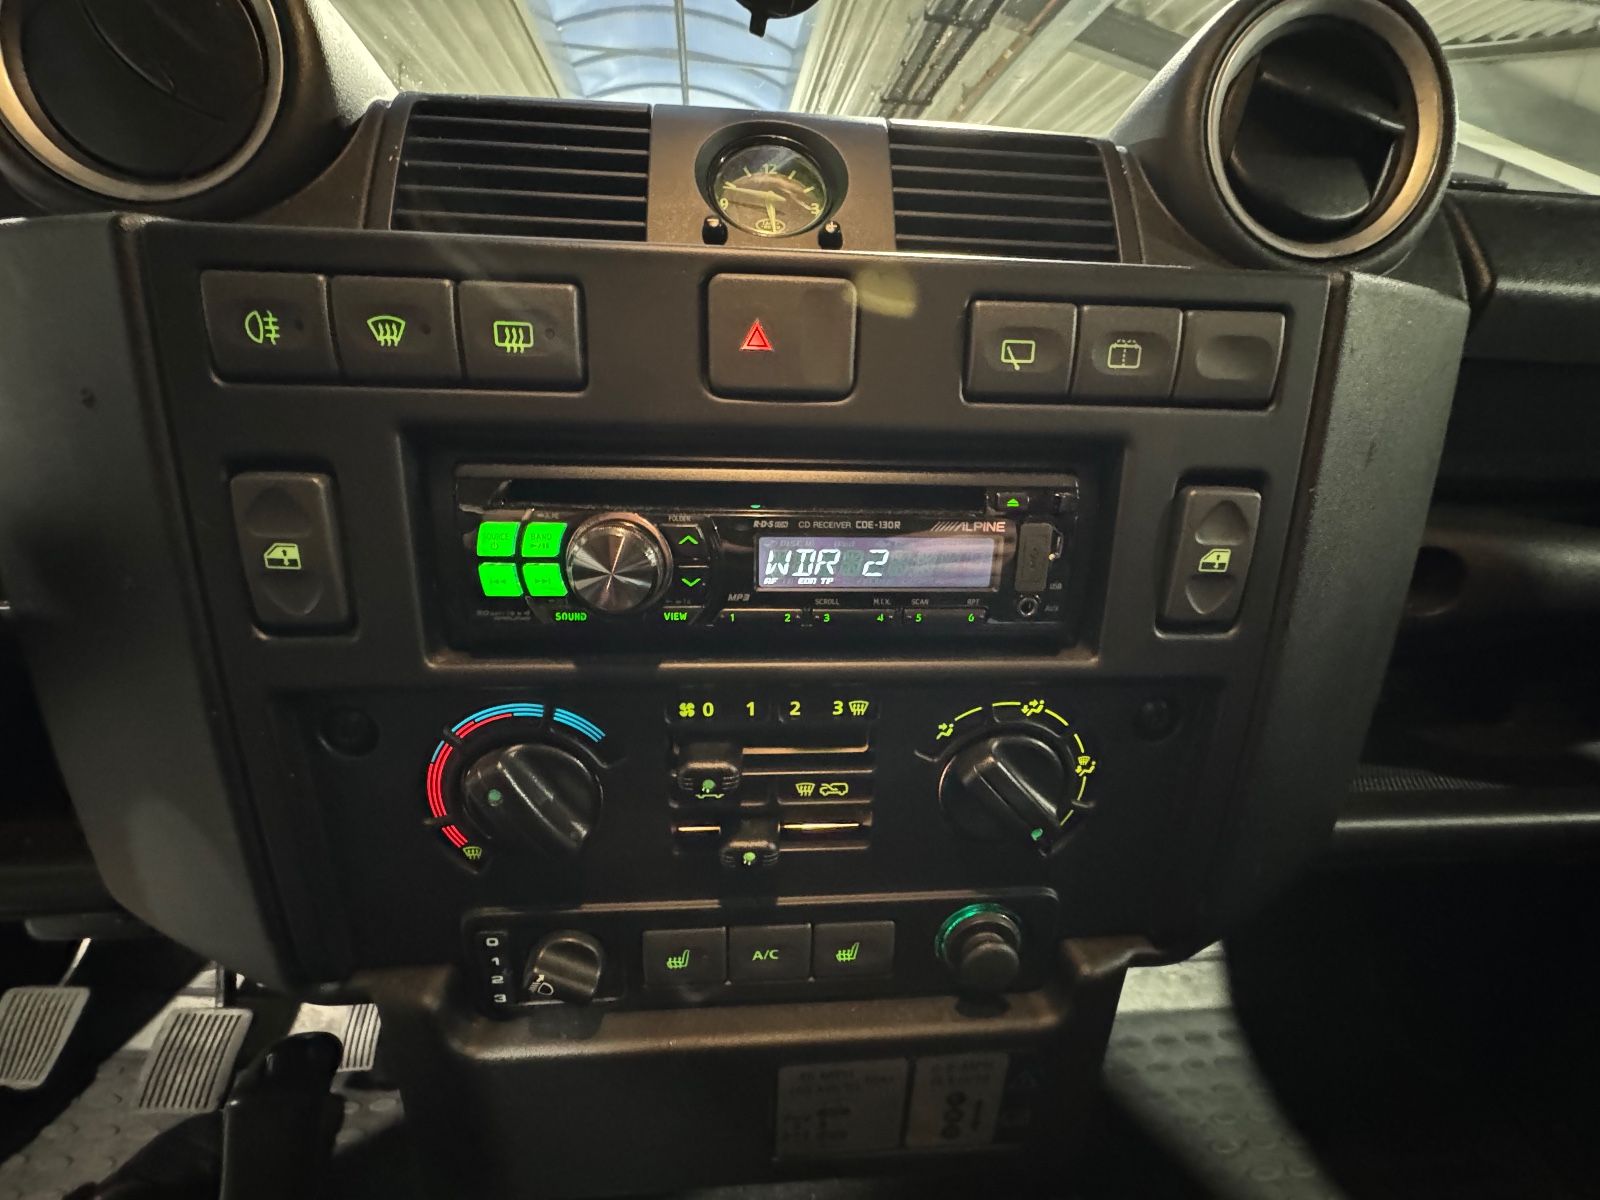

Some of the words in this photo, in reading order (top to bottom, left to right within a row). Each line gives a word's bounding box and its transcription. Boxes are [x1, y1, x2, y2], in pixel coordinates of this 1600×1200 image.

[762, 164, 777, 174] 12
[719, 198, 729, 210] 9
[810, 203, 820, 215] 3
[798, 520, 812, 529] CD
[813, 520, 852, 529] RECEIVER
[855, 520, 901, 530] CDE-130R
[953, 521, 1006, 532] ALPINE
[530, 533, 552, 541] BAND
[764, 548, 841, 577] WDR
[861, 548, 890, 577] 2
[728, 593, 750, 602] MP3
[815, 598, 840, 606] SCROLL
[911, 598, 929, 606] SCAN
[554, 611, 588, 622] SOUND
[663, 611, 688, 621] VIEW
[729, 613, 736, 623] 1
[784, 613, 791, 623] 2
[823, 613, 830, 623] 3
[877, 613, 884, 623] 4
[915, 613, 922, 623] 5
[968, 613, 975, 623] 6
[702, 701, 715, 717] 0
[746, 701, 756, 717] 1
[790, 701, 801, 716] 2
[832, 701, 844, 716] 3
[485, 937, 499, 947] 0
[751, 949, 779, 962] A/C
[491, 957, 500, 966] 1
[491, 975, 504, 984] 2
[493, 993, 507, 1003] 3
